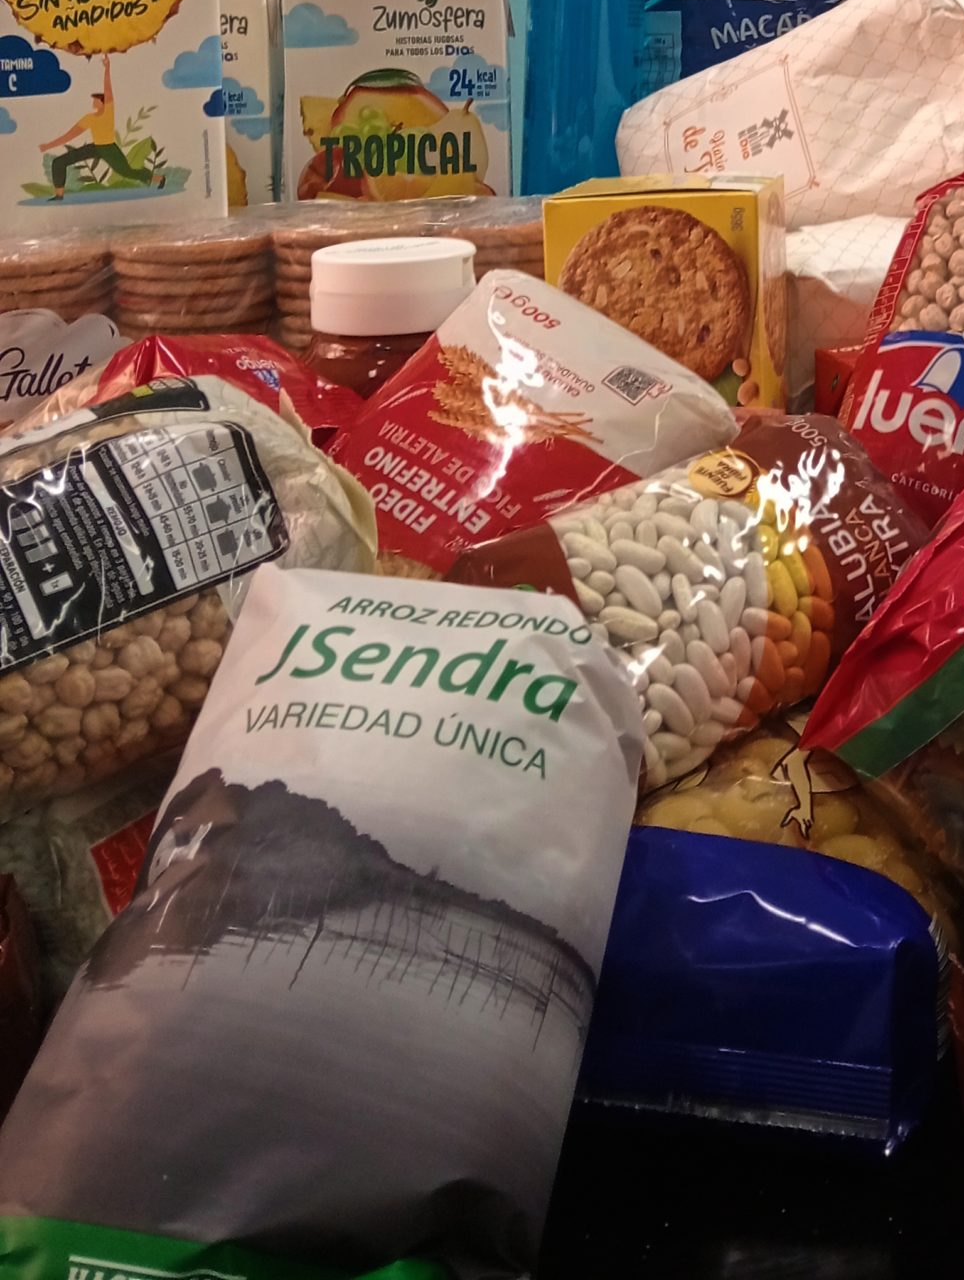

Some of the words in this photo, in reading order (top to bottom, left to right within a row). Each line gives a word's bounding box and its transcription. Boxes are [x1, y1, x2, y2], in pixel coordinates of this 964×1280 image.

[0, 58, 33, 70] TAMINA
[385, 48, 404, 56] PARA
[406, 48, 428, 56] TODOS
[430, 47, 443, 55] LOS
[395, 36, 432, 44] HISTORIAS
[9, 74, 17, 91] C
[449, 69, 475, 97] 24
[476, 68, 497, 83] kcal
[320, 131, 477, 180] TROPICAL
[378, 419, 454, 469] ALETRIA
[363, 446, 493, 534] ENTREFINO
[443, 457, 475, 484] DE
[104, 503, 128, 537] REMOJO
[368, 485, 437, 534] FIDEO
[0, 545, 28, 594] EPARACIÓN
[809, 496, 874, 621] ALUBIA
[327, 595, 439, 625] ARROZ
[437, 609, 593, 646] REDONDO
[254, 623, 578, 723] JSendra
[244, 701, 423, 740] VARIEDAD
[433, 711, 548, 779] ÚNICA
